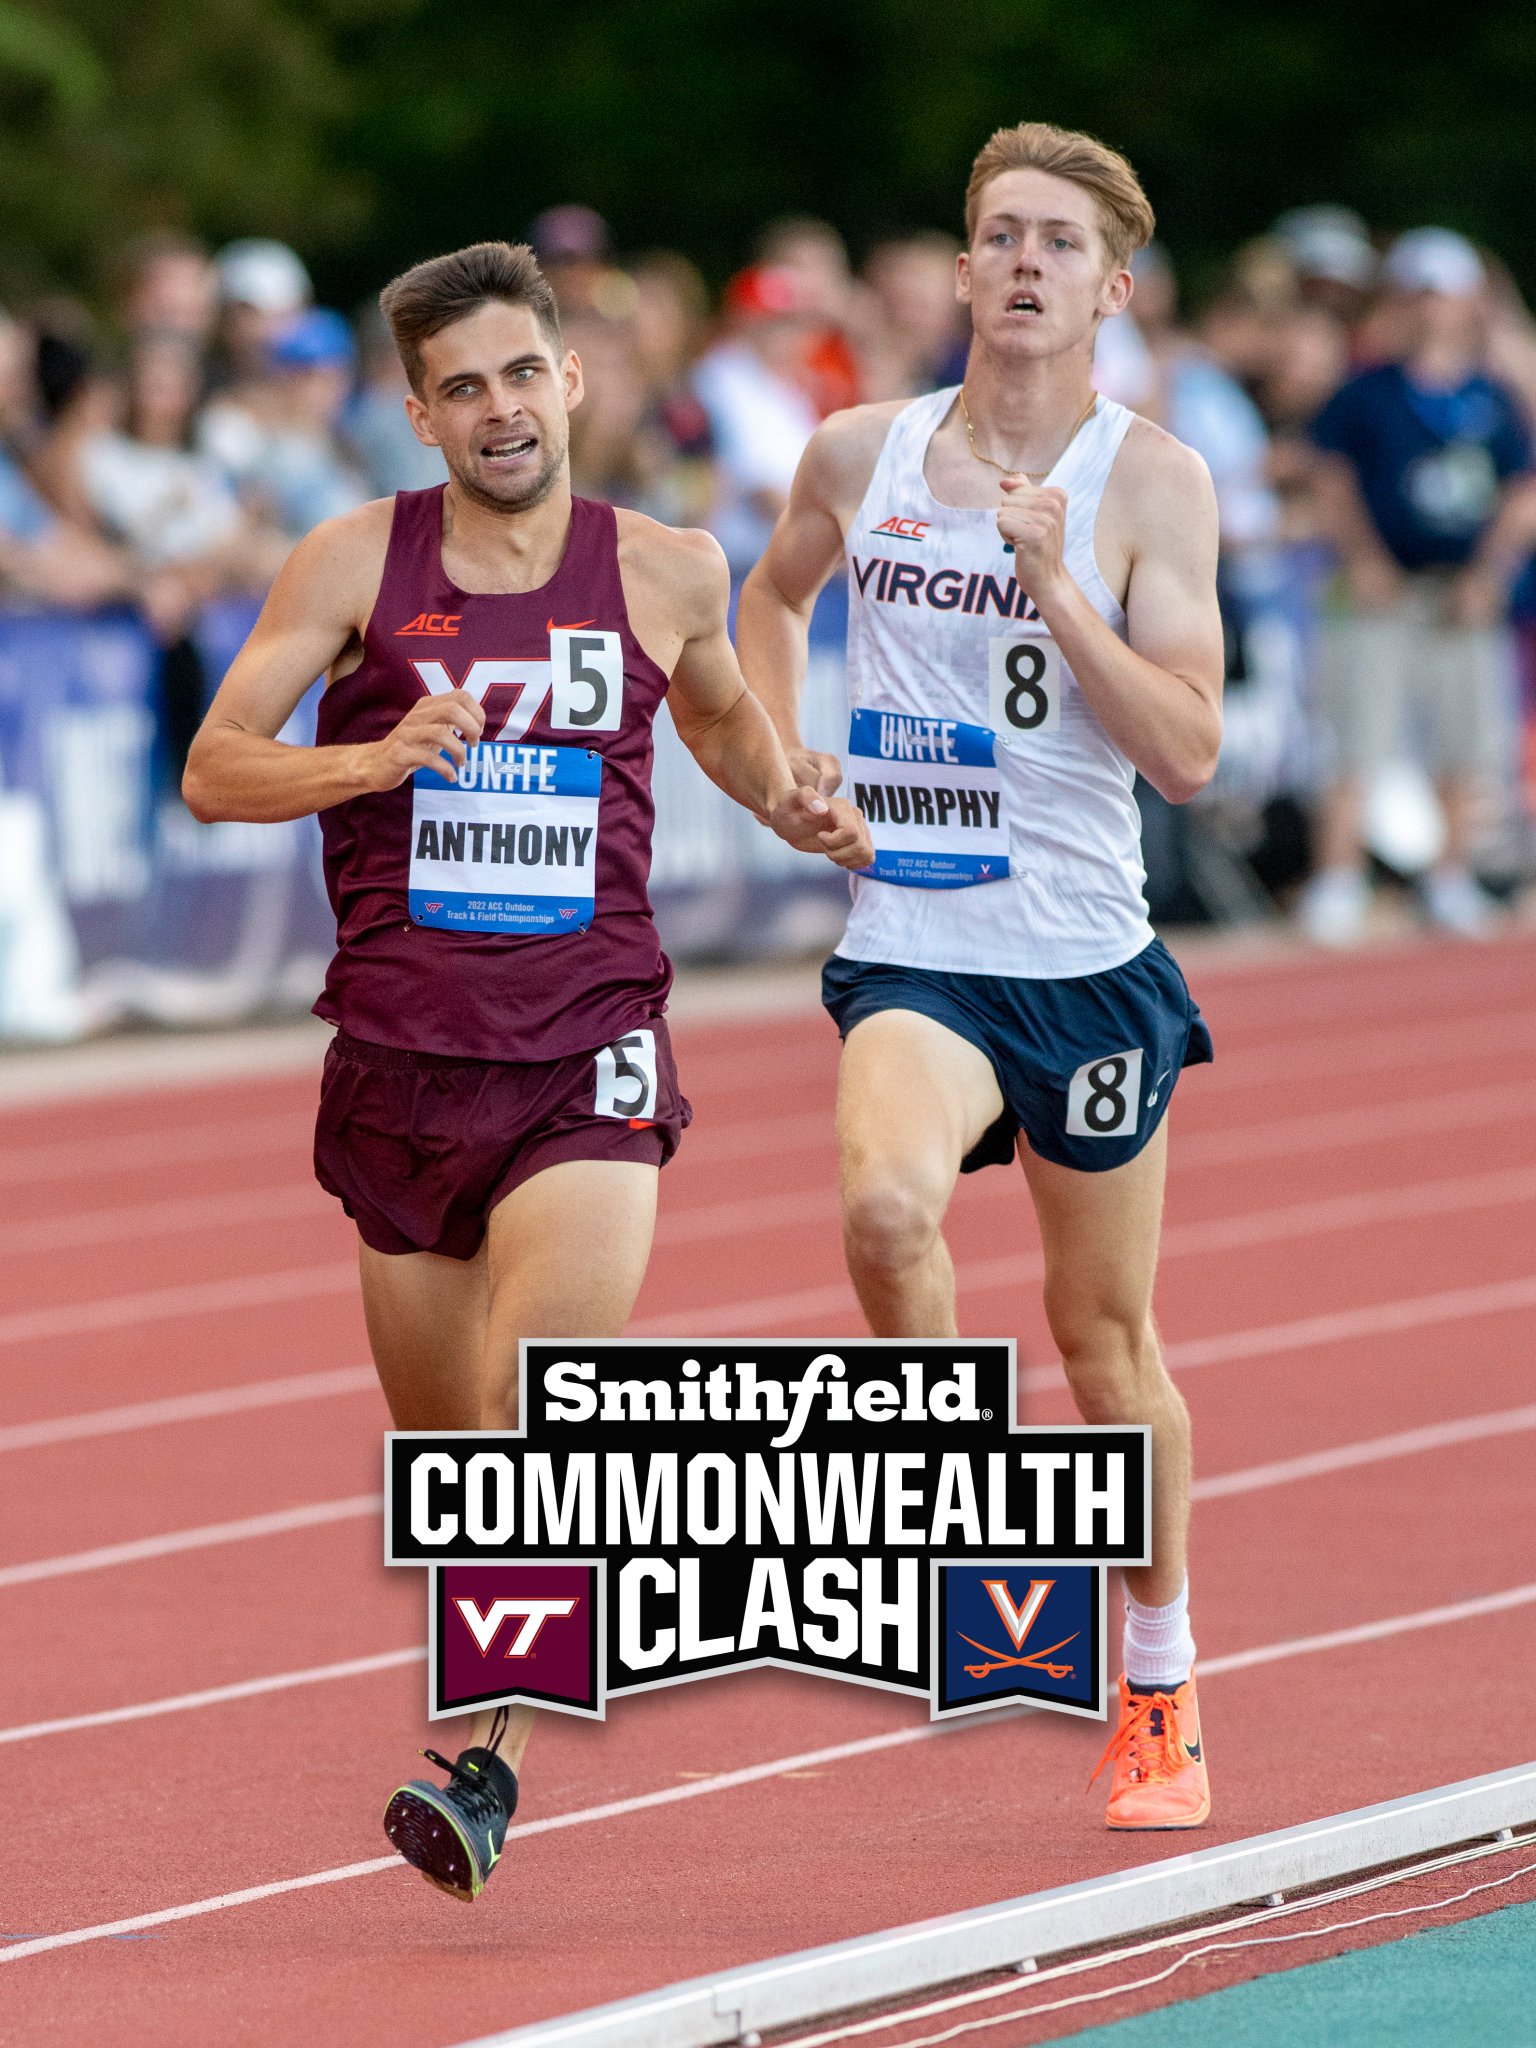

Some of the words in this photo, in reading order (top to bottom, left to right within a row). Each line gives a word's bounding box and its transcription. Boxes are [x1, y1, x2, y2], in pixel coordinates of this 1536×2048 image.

[876, 516, 932, 538] ACC
[852, 556, 1041, 622] VIRGINI
[398, 613, 463, 633] ACC
[568, 637, 608, 726] 5
[1005, 644, 1048, 729] 8
[880, 714, 959, 763] UNITE
[498, 764, 522, 773] ACC
[854, 783, 1000, 829] MURPHY
[415, 820, 593, 867] ANTHONY
[879, 867, 897, 877] Track
[905, 869, 922, 879] Field
[923, 870, 973, 881] Championships
[898, 858, 914, 868] 2022
[915, 859, 929, 868] ACC
[930, 860, 956, 870] Outdoor
[424, 902, 443, 913] VT
[447, 910, 468, 920] Track
[469, 912, 476, 921] &
[478, 912, 497, 922] Field
[498, 913, 555, 925] Championships
[467, 901, 486, 911] 2022
[488, 902, 503, 911] ACC
[505, 902, 535, 912] Outdoor
[558, 908, 577, 920] VT
[612, 1035, 650, 1117] 5
[1084, 1057, 1127, 1132] 8
